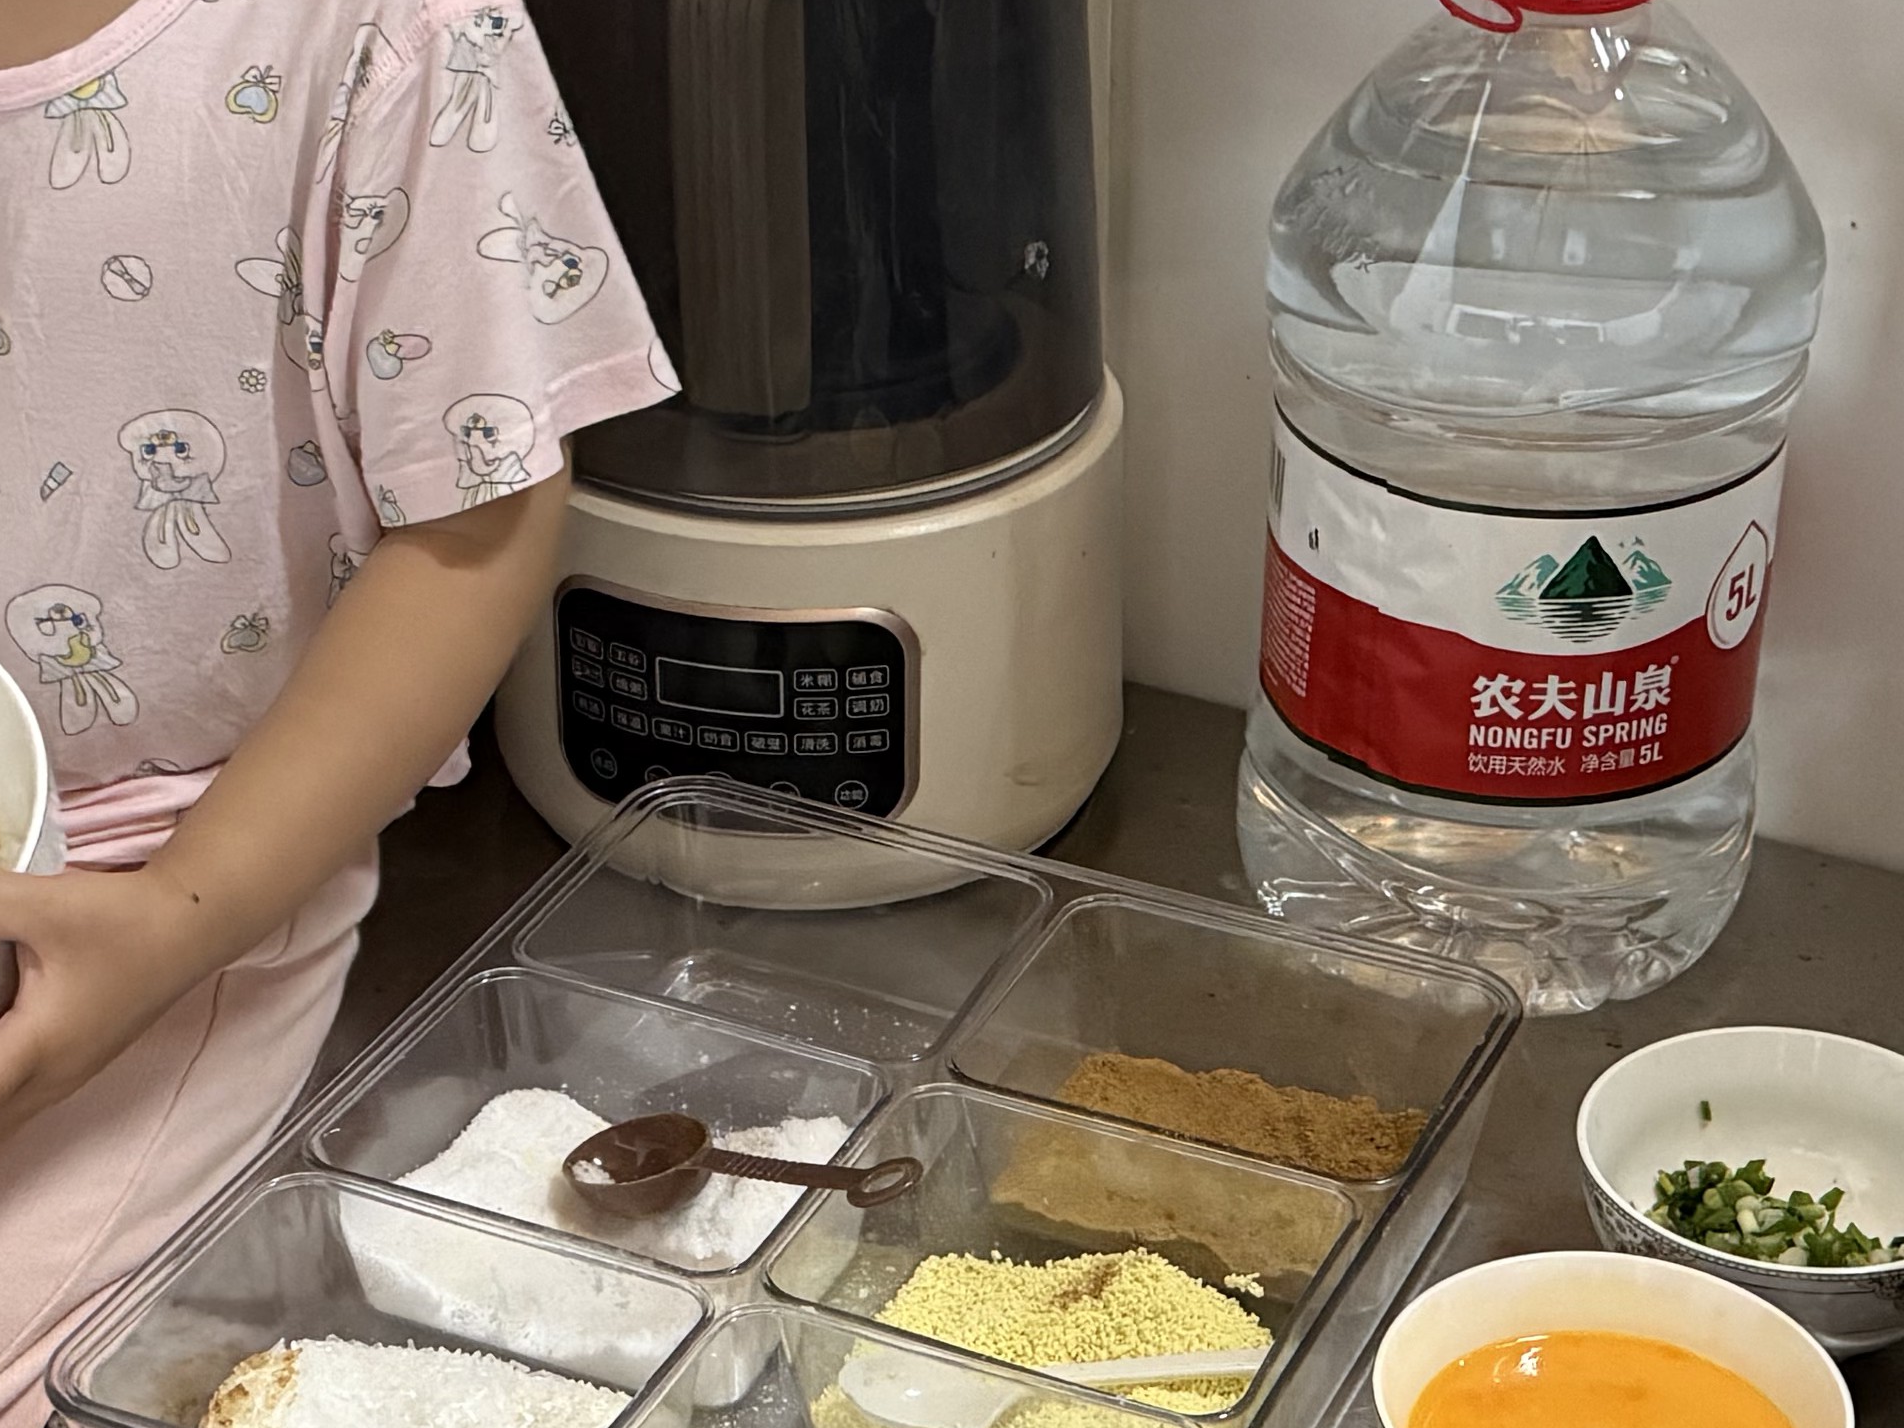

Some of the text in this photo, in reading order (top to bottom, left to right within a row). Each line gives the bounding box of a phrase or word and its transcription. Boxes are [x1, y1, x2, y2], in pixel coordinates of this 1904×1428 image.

[1726, 563, 1756, 621] 5L
[1470, 664, 1673, 721] 农夫山泉
[1468, 713, 1669, 750] NONGFU SPRING
[1467, 741, 1664, 778] 饮用天然水 净含量 5L
